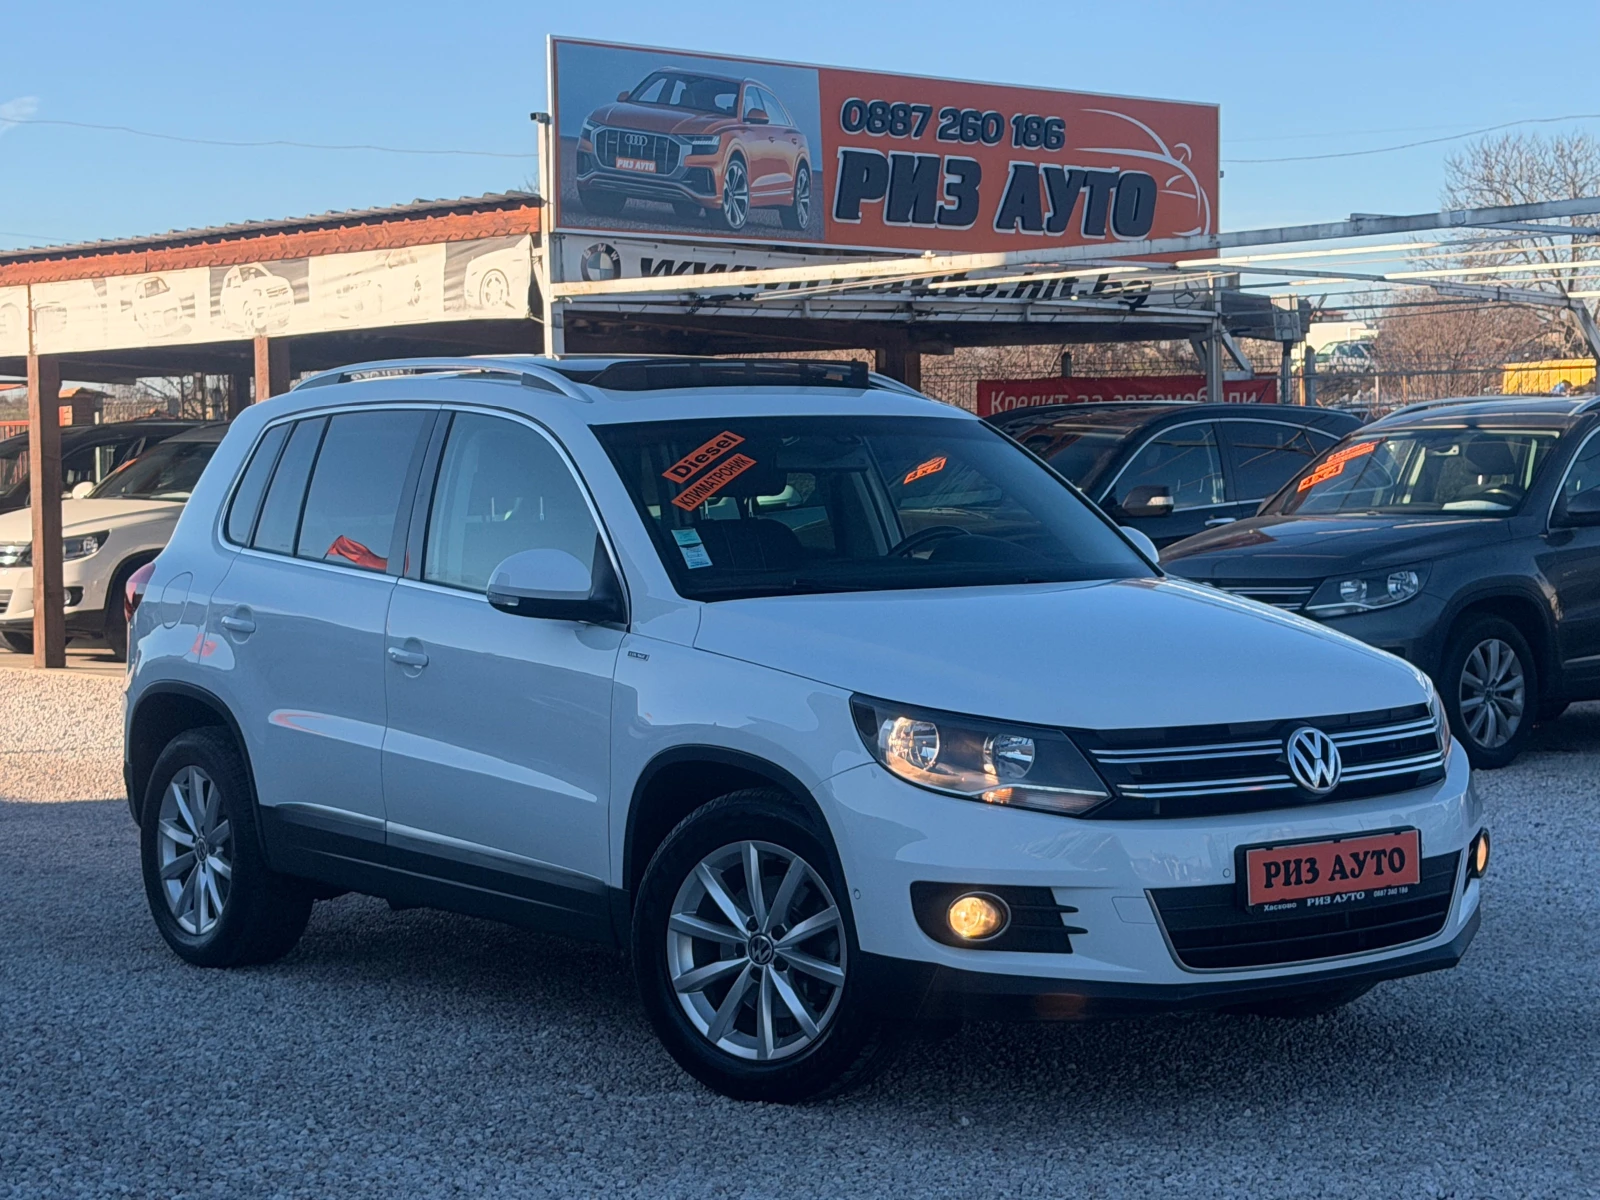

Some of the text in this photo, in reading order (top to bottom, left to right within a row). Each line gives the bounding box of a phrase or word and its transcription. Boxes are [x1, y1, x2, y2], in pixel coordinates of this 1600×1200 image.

[841, 98, 1066, 151] 0887 260 186
[833, 147, 1158, 241] РИЗ АУТО
[670, 433, 738, 478] Diesel
[680, 456, 751, 507] КЛИМАТРОНИК
[1262, 847, 1406, 889] РИЗ АУТО
[1306, 897, 1332, 907] РИЗ
[1333, 891, 1366, 903] АУТО
